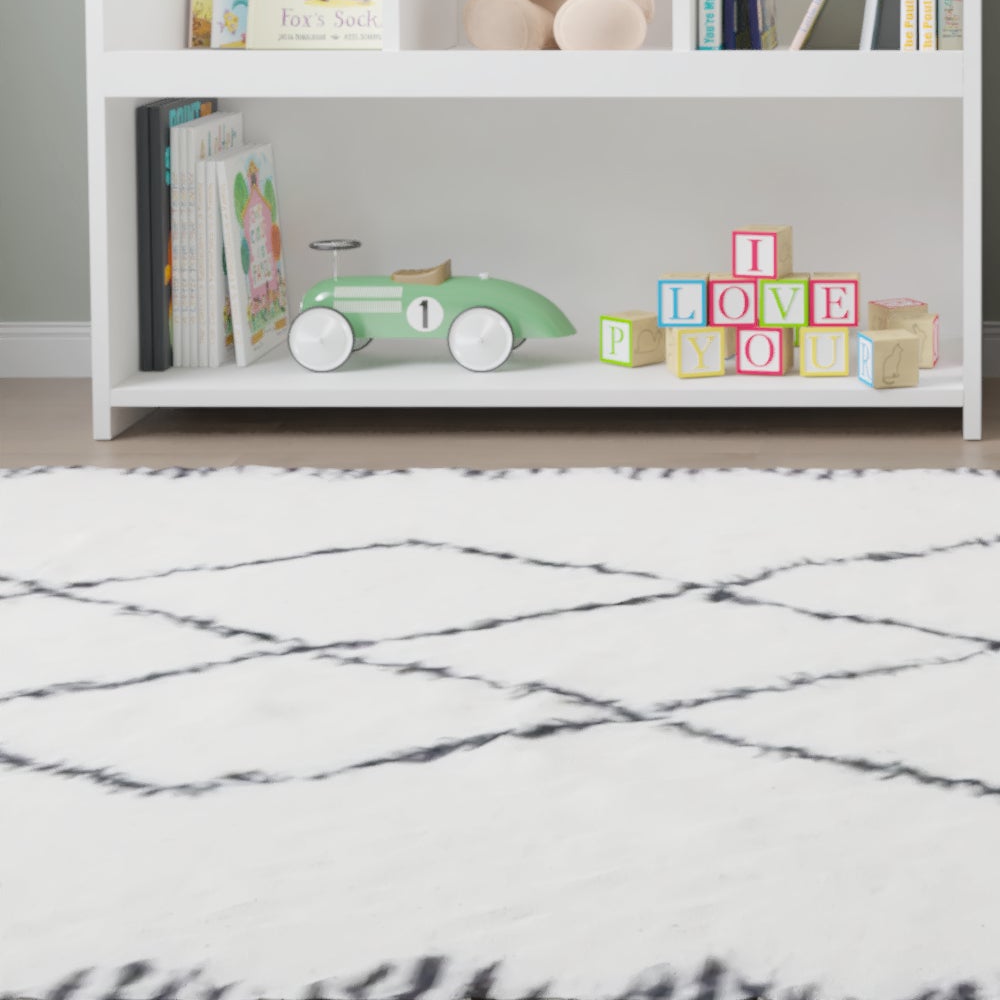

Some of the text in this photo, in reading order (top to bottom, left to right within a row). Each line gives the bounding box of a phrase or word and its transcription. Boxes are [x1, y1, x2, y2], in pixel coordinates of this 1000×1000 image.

[280, 8, 326, 28] Fox's
[703, 13, 714, 44] You're
[747, 238, 763, 272] I
[419, 300, 428, 329] 1
[669, 286, 849, 320] LOVE
[610, 326, 624, 356] P
[689, 333, 837, 370] YOU
[860, 342, 872, 380] R
